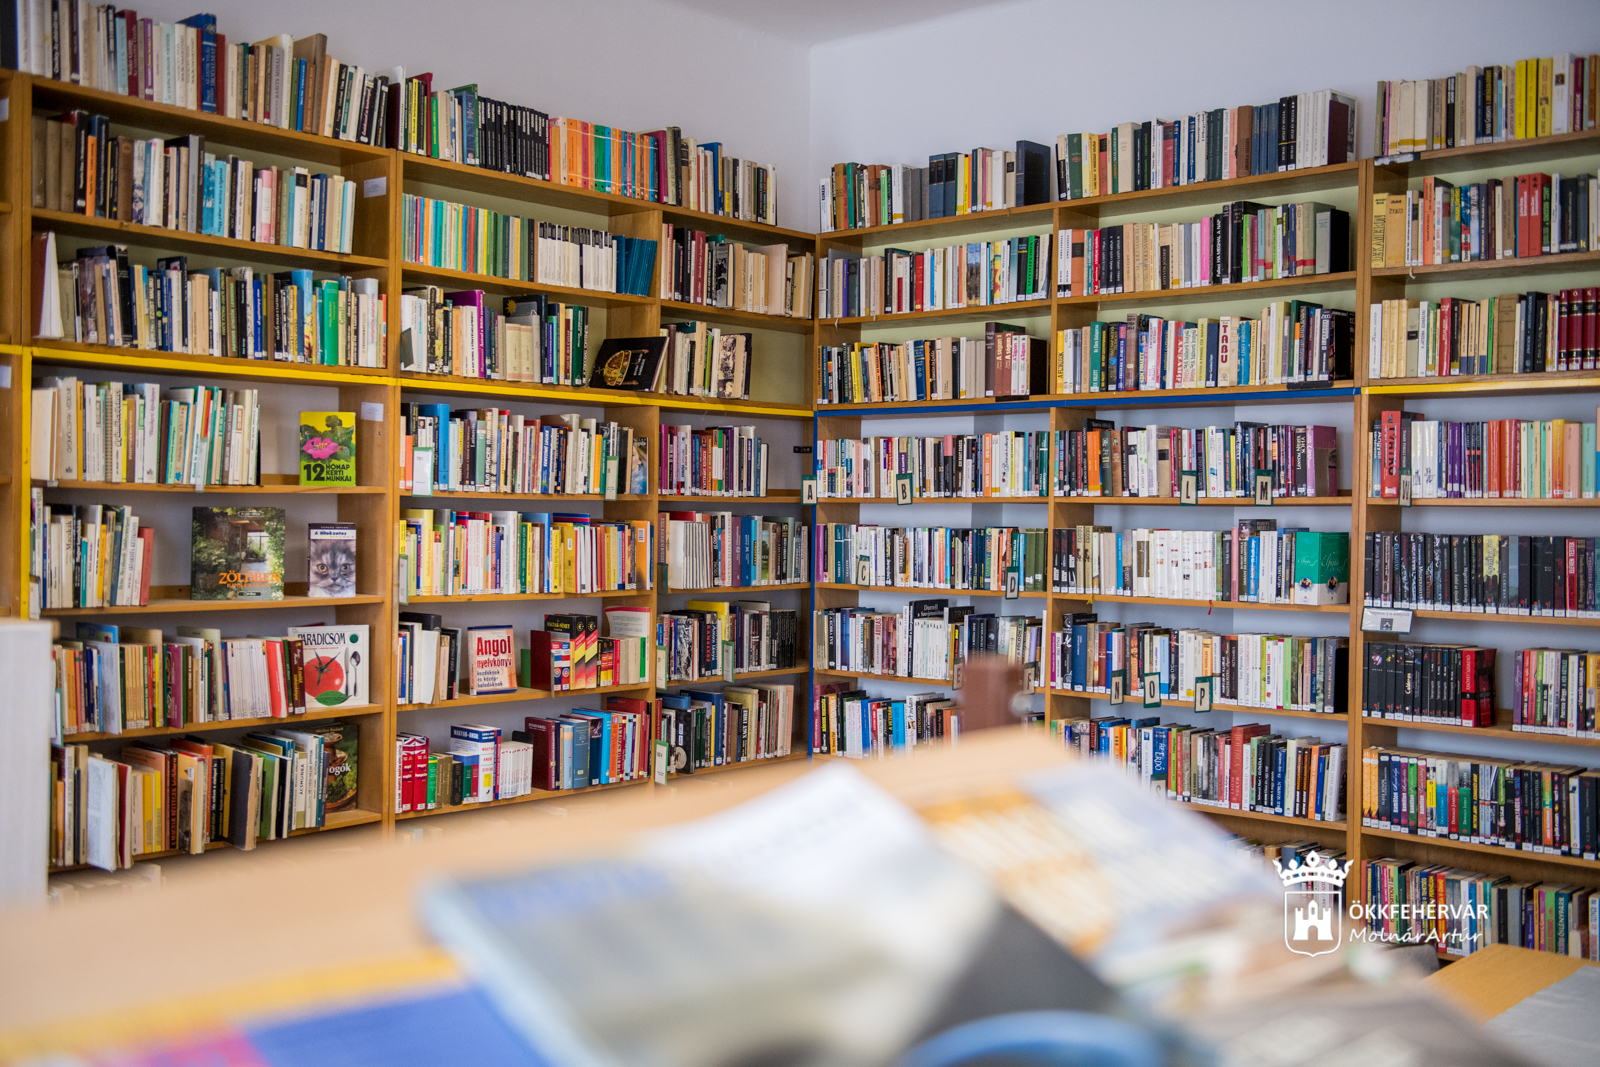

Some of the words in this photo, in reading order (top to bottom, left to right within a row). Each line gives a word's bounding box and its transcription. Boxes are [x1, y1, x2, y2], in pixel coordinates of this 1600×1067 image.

[1220, 325, 1228, 363] TABU
[303, 463, 325, 481] 12
[807, 485, 813, 500] A
[901, 484, 907, 500] B
[1185, 481, 1191, 499] L
[1260, 481, 1269, 501] M
[219, 570, 281, 585] ZÖLDBEN
[860, 565, 866, 581] C
[1010, 577, 1016, 593] D
[298, 632, 346, 646] PARADICSOM
[476, 635, 512, 656] Angol
[476, 657, 512, 669] nyelvkönyv
[1027, 672, 1033, 690] F
[1149, 680, 1155, 698] O
[1199, 687, 1206, 706] P
[1556, 897, 1564, 937] ŐSLÉNYPARK
